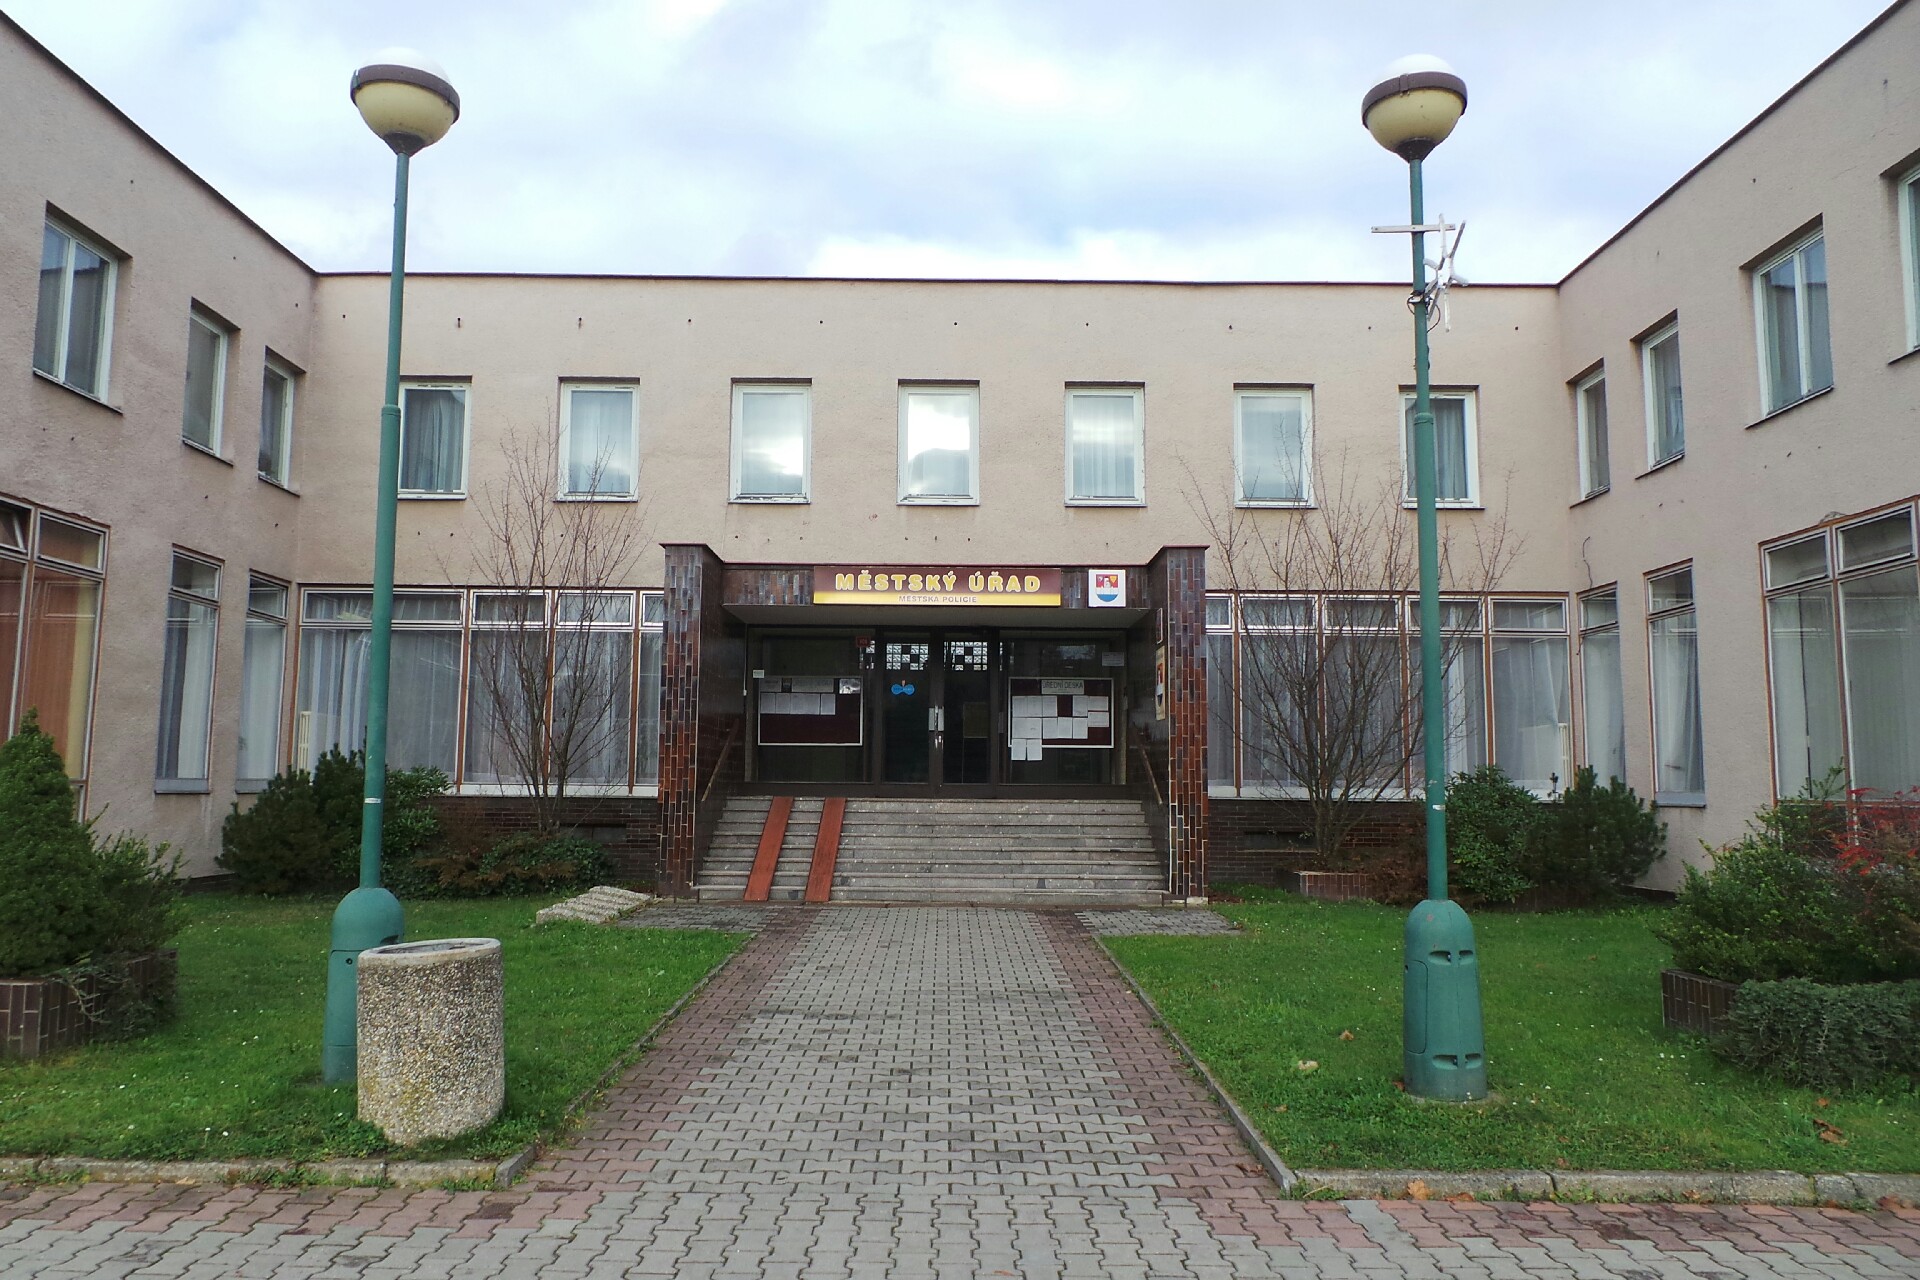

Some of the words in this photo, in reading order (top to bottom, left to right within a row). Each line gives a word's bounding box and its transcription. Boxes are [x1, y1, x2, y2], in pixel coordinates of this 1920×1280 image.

[835, 570, 956, 591] MĚSTSKÝ
[968, 571, 1041, 592] ÚŘAD
[942, 595, 977, 603] POLICIE
